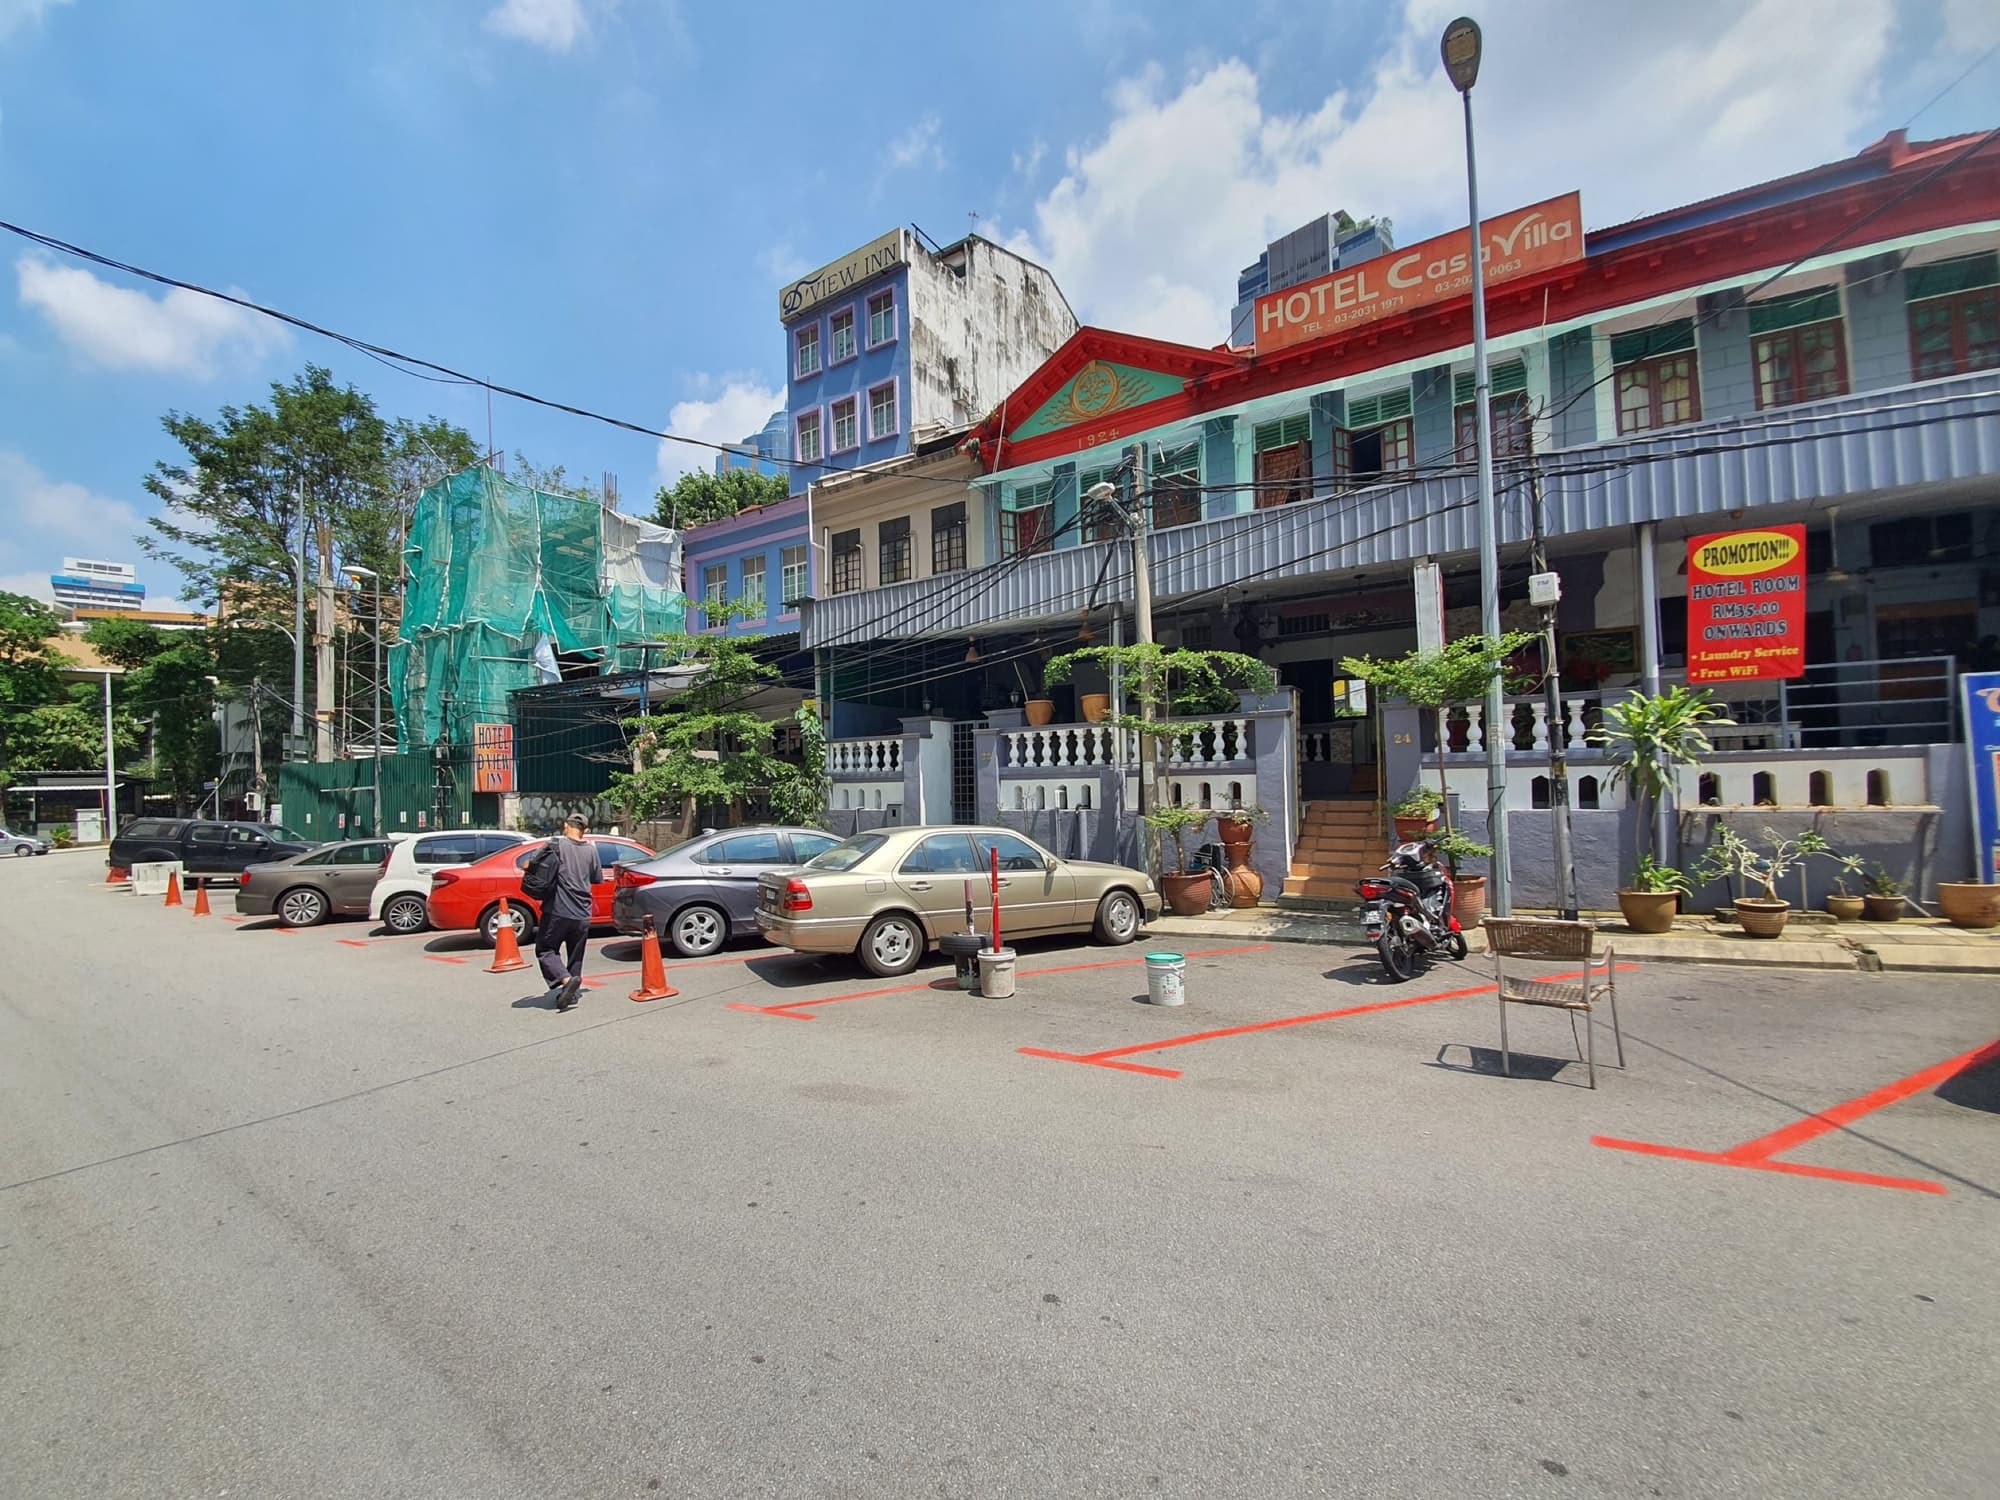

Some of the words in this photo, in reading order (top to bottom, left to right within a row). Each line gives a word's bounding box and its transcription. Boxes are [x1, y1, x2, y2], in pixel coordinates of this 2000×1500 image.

[783, 262, 858, 315] D'VIEW
[864, 243, 897, 275] INN
[1262, 271, 1380, 333] HOTEL
[1491, 212, 1572, 257] Villa
[1302, 321, 1323, 334] TEL
[1334, 303, 1377, 324] 03-2031
[1381, 295, 1404, 312] 1971
[1489, 259, 1522, 278] 0063
[1078, 428, 1119, 450] 1924
[1703, 539, 1790, 568] PROMOTION!!!
[1692, 581, 1746, 599] HOTEL
[1752, 576, 1800, 594] ROOM
[1711, 602, 1779, 619] RM35.00
[1703, 620, 1788, 640] ONWARDS
[1700, 649, 1751, 661] Laundry
[1754, 646, 1800, 658] Service
[1700, 667, 1727, 678] Free
[478, 727, 509, 750] HOTEL
[1394, 733, 1412, 744] 24
[486, 772, 502, 789] INN
